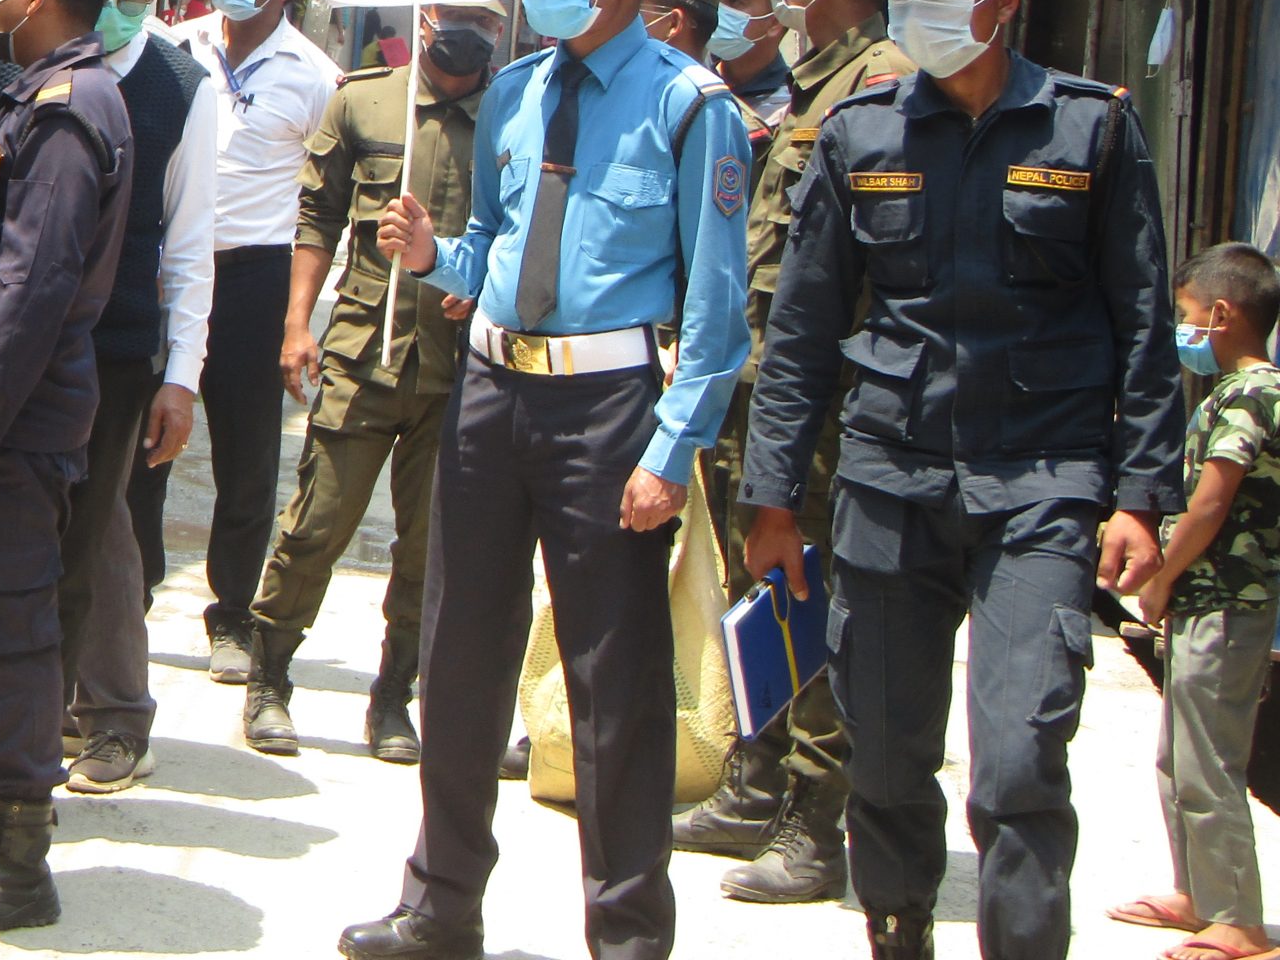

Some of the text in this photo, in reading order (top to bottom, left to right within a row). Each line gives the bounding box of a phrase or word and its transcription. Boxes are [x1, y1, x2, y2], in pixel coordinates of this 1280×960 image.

[889, 177, 915, 187] SHAH
[1011, 171, 1085, 186] NEPAL POLICE
